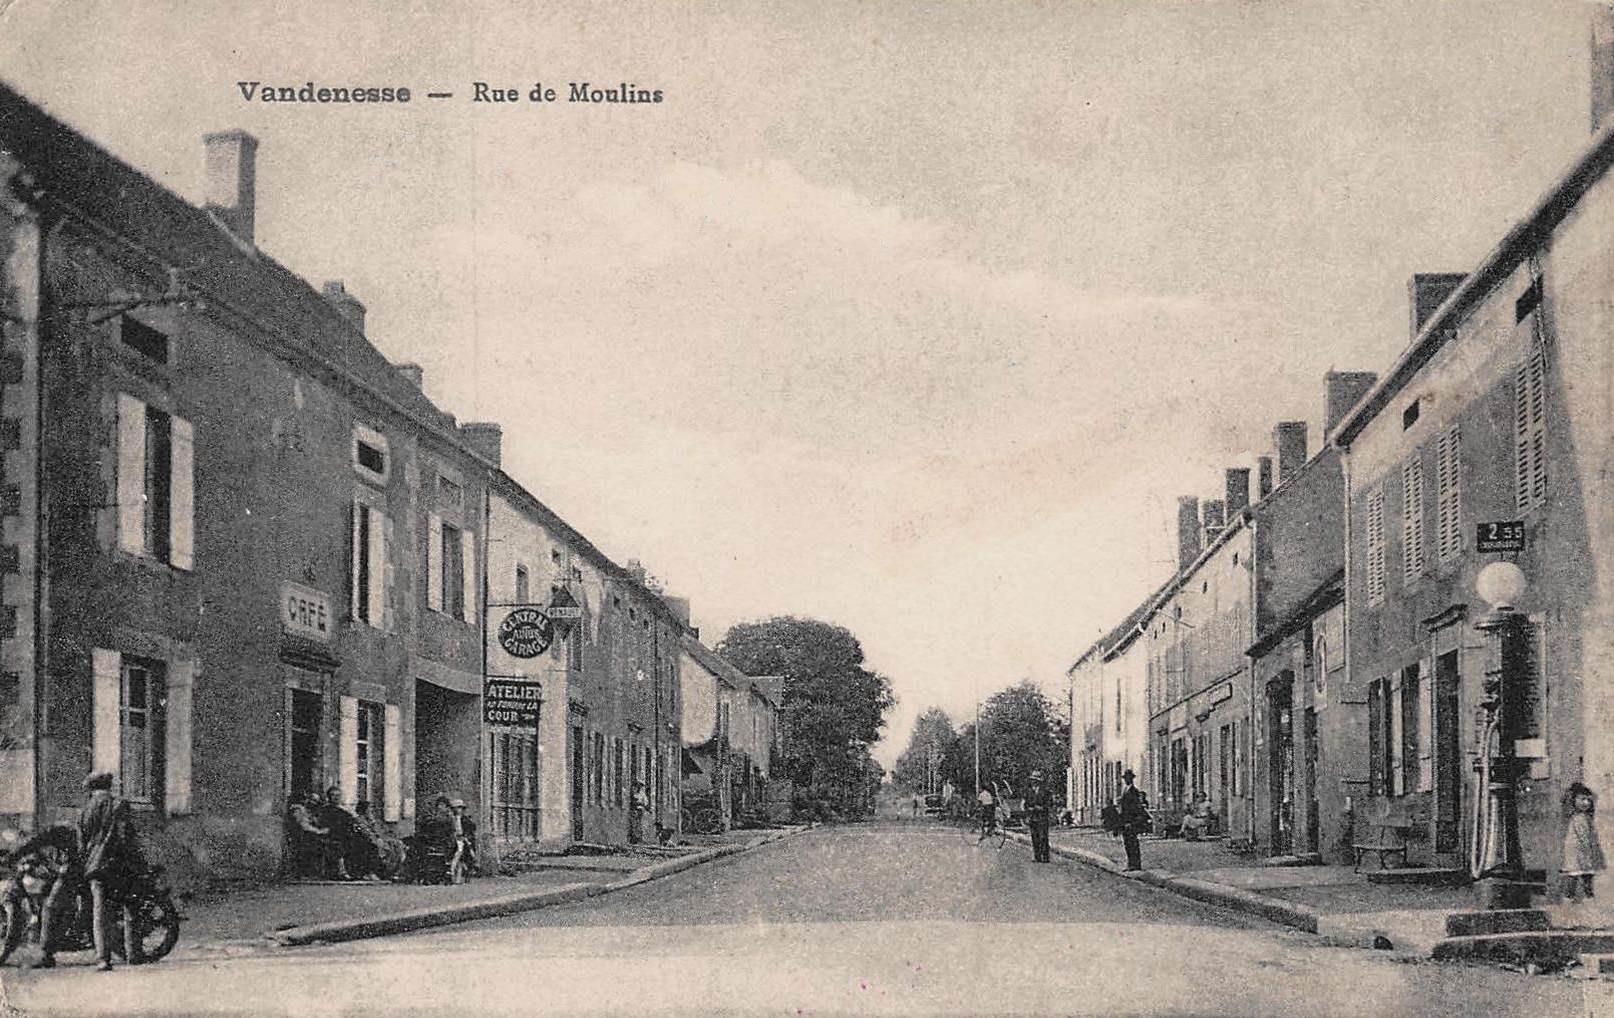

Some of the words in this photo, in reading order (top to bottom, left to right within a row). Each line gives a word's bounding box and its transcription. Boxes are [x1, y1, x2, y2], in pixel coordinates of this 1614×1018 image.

[1489, 523, 1498, 539] 2
[502, 611, 548, 632] CENTRAL
[504, 638, 547, 656] GARAGE
[488, 685, 541, 699] ATELIER
[488, 711, 518, 721] COUR
